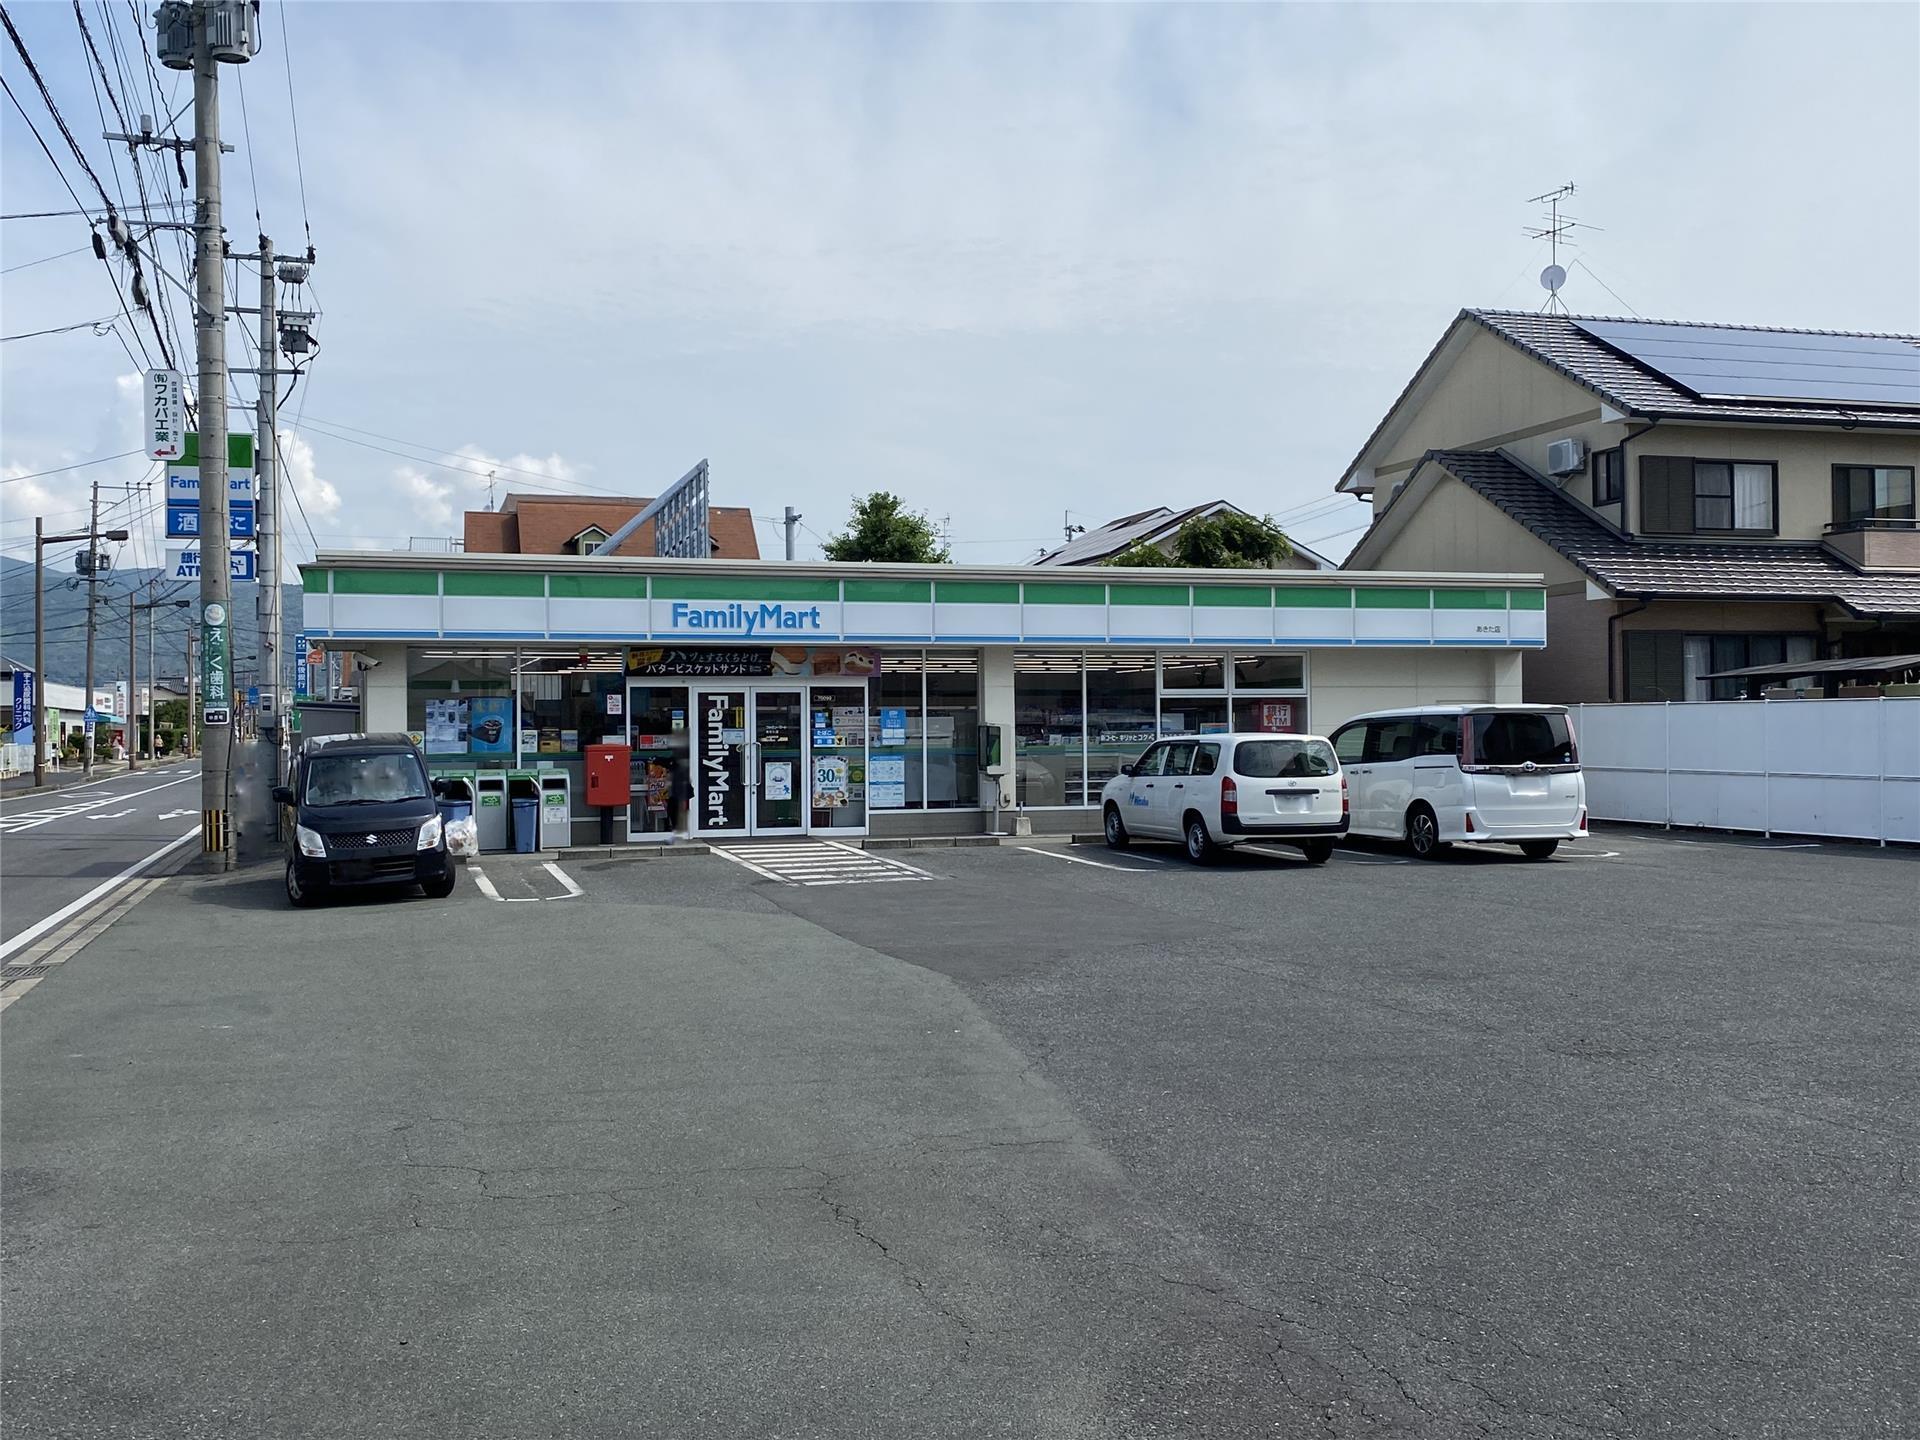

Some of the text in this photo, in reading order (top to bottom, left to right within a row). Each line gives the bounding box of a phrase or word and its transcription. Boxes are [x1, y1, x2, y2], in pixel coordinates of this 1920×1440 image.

[153, 373, 170, 442] (有)ワカバ工業
[178, 513, 198, 531] 酒
[672, 603, 820, 636] FamilyMart
[1476, 625, 1501, 633] あきた店
[297, 659, 306, 688] 肥後銀行
[646, 663, 746, 674] バタービスケットサンド
[702, 695, 730, 826] FamilyMart
